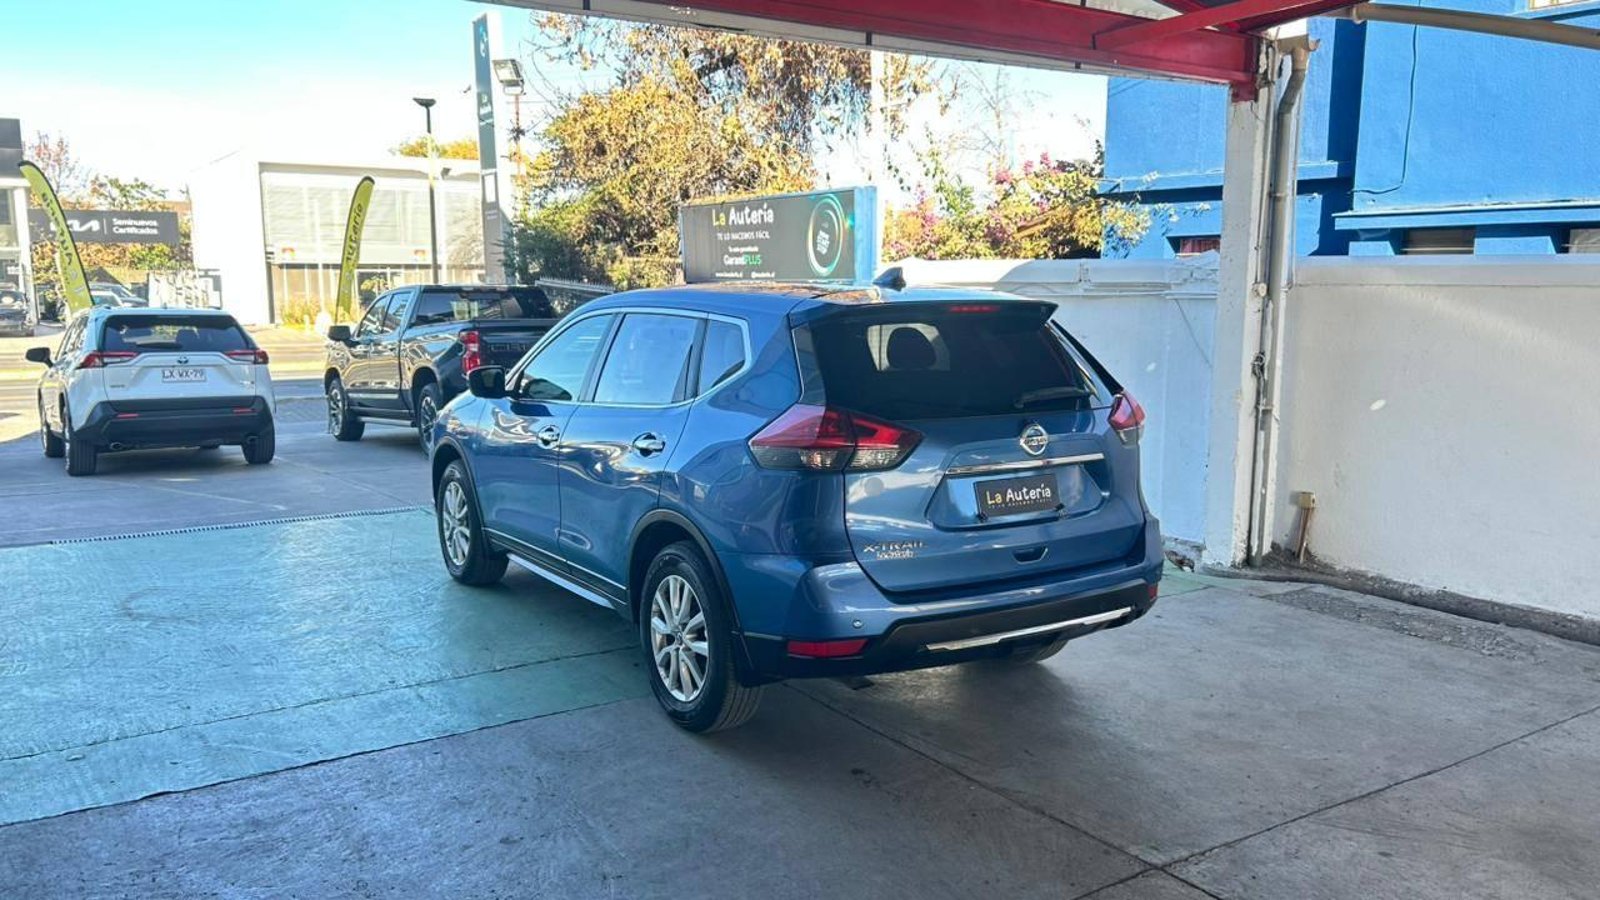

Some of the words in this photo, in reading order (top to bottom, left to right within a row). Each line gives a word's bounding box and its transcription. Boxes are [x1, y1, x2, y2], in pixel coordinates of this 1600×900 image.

[112, 218, 158, 226] Seminuevos
[712, 209, 726, 227] La
[728, 203, 774, 225] Autería
[112, 226, 159, 235] Certificados
[985, 490, 1003, 505] La
[1005, 483, 1052, 502] Autería
